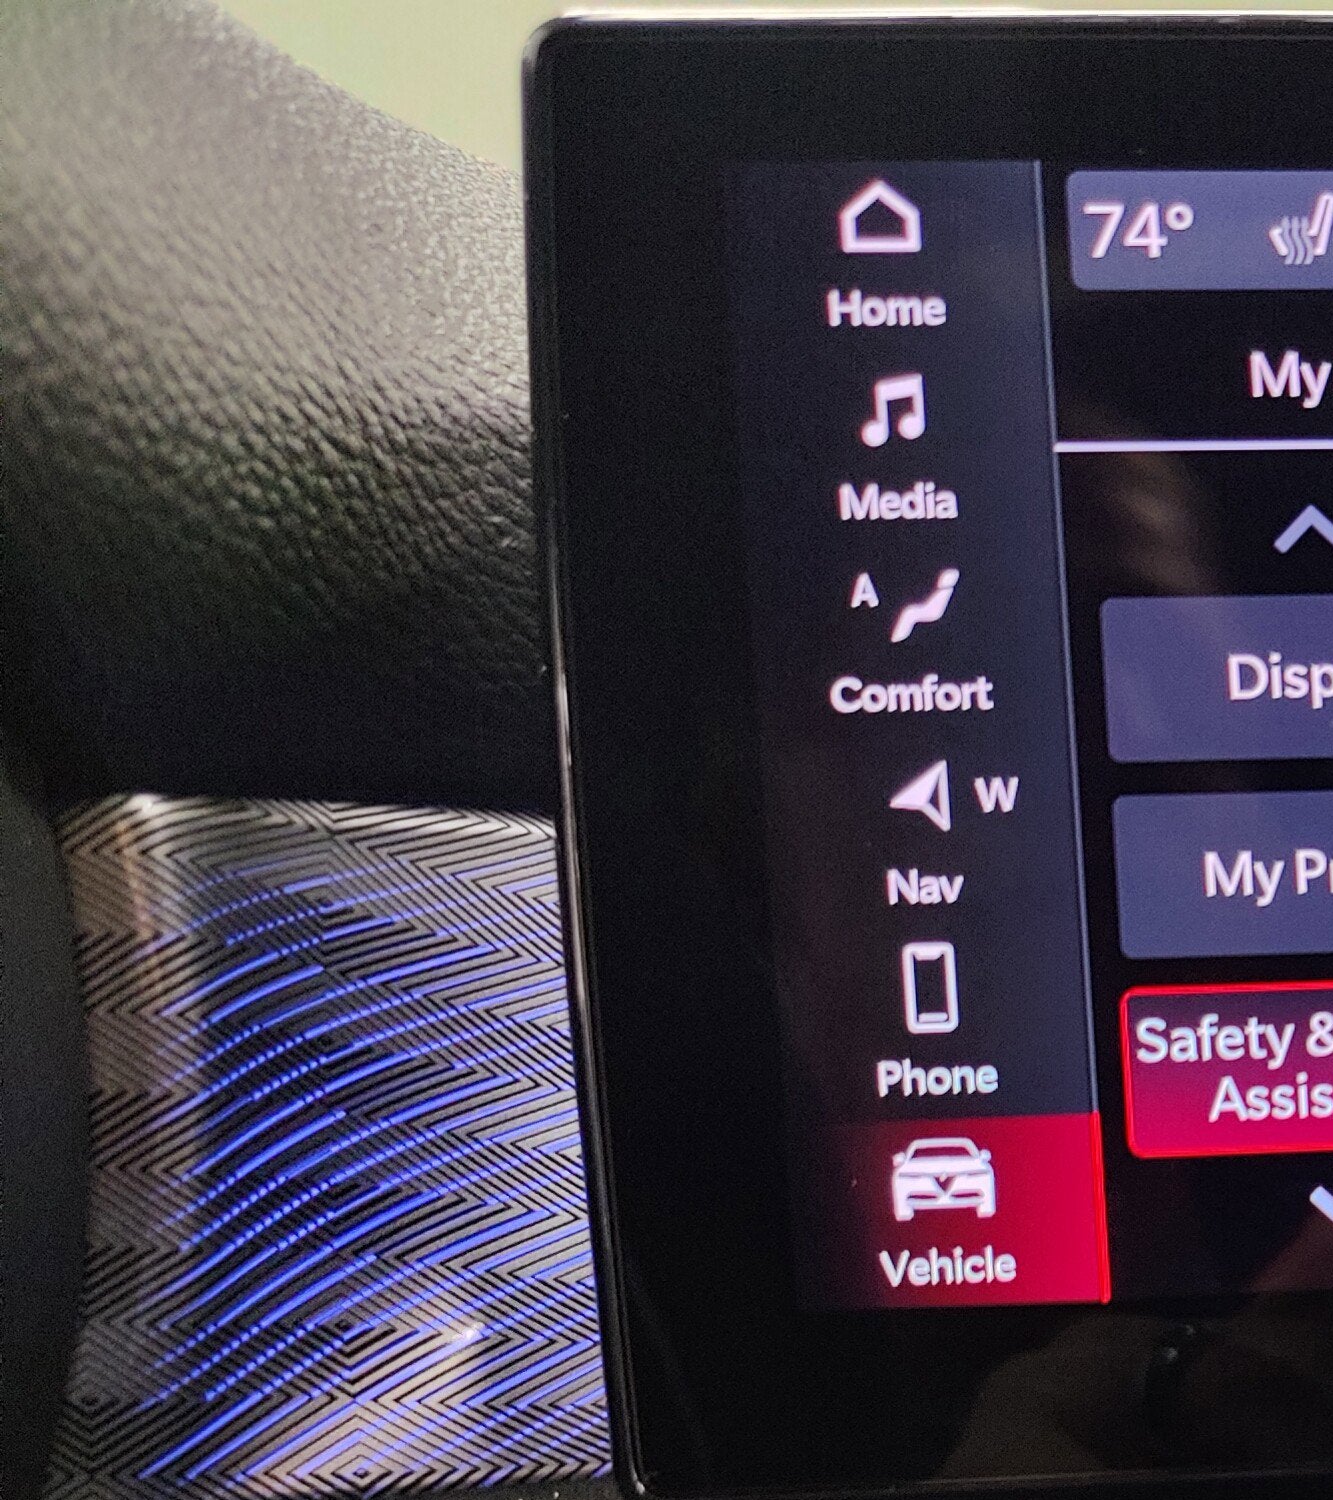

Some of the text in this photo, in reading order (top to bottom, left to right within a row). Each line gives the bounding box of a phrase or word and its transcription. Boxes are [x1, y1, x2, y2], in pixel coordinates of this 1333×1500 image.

[1083, 201, 1195, 259] 74°
[826, 289, 947, 327] Home
[1249, 351, 1332, 409] My
[838, 482, 959, 521] Media
[850, 572, 880, 608] A
[829, 674, 993, 714] Comfort
[974, 776, 1019, 813] W
[886, 868, 964, 905] Nav
[1203, 849, 1284, 907] My
[1135, 1014, 1296, 1070] Safety
[877, 1059, 999, 1098] Phone
[879, 1245, 1017, 1287] Vehicle
